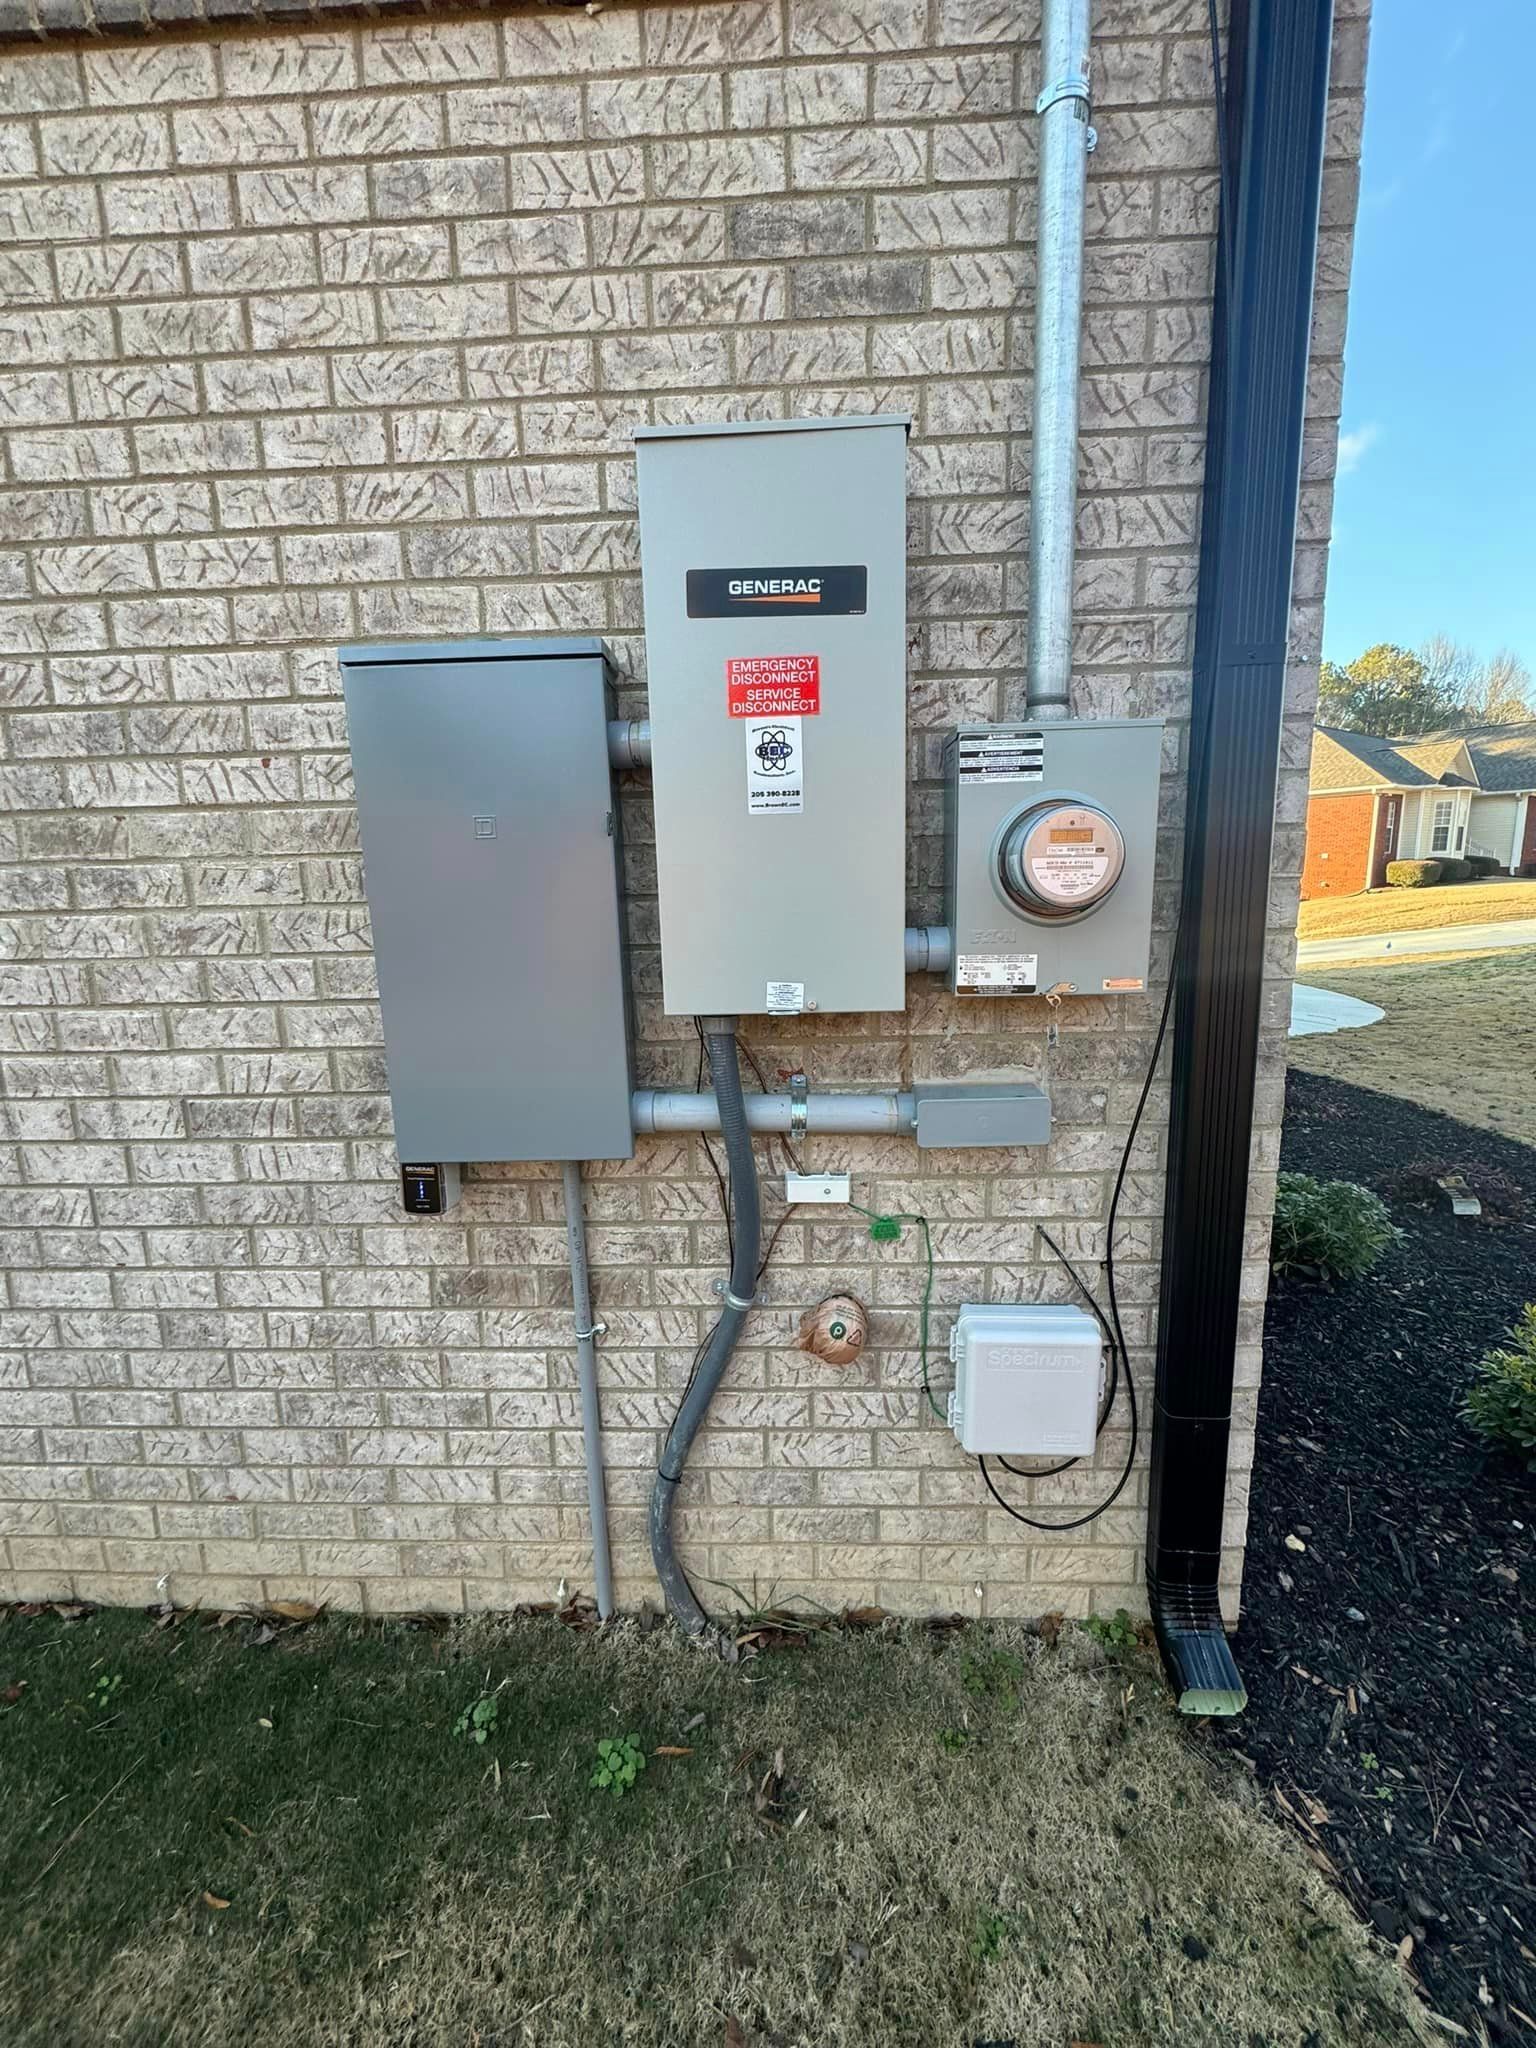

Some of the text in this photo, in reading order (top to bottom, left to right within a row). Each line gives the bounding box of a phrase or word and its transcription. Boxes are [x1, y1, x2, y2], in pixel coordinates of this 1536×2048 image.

[729, 579, 821, 595] GENERAC
[732, 658, 815, 673] EMERGENCY
[731, 670, 816, 685] DISCONNECT
[746, 687, 801, 701] SERVICE
[732, 699, 816, 714] DISCONNECT
[987, 1350, 1075, 1370] Spectrum
